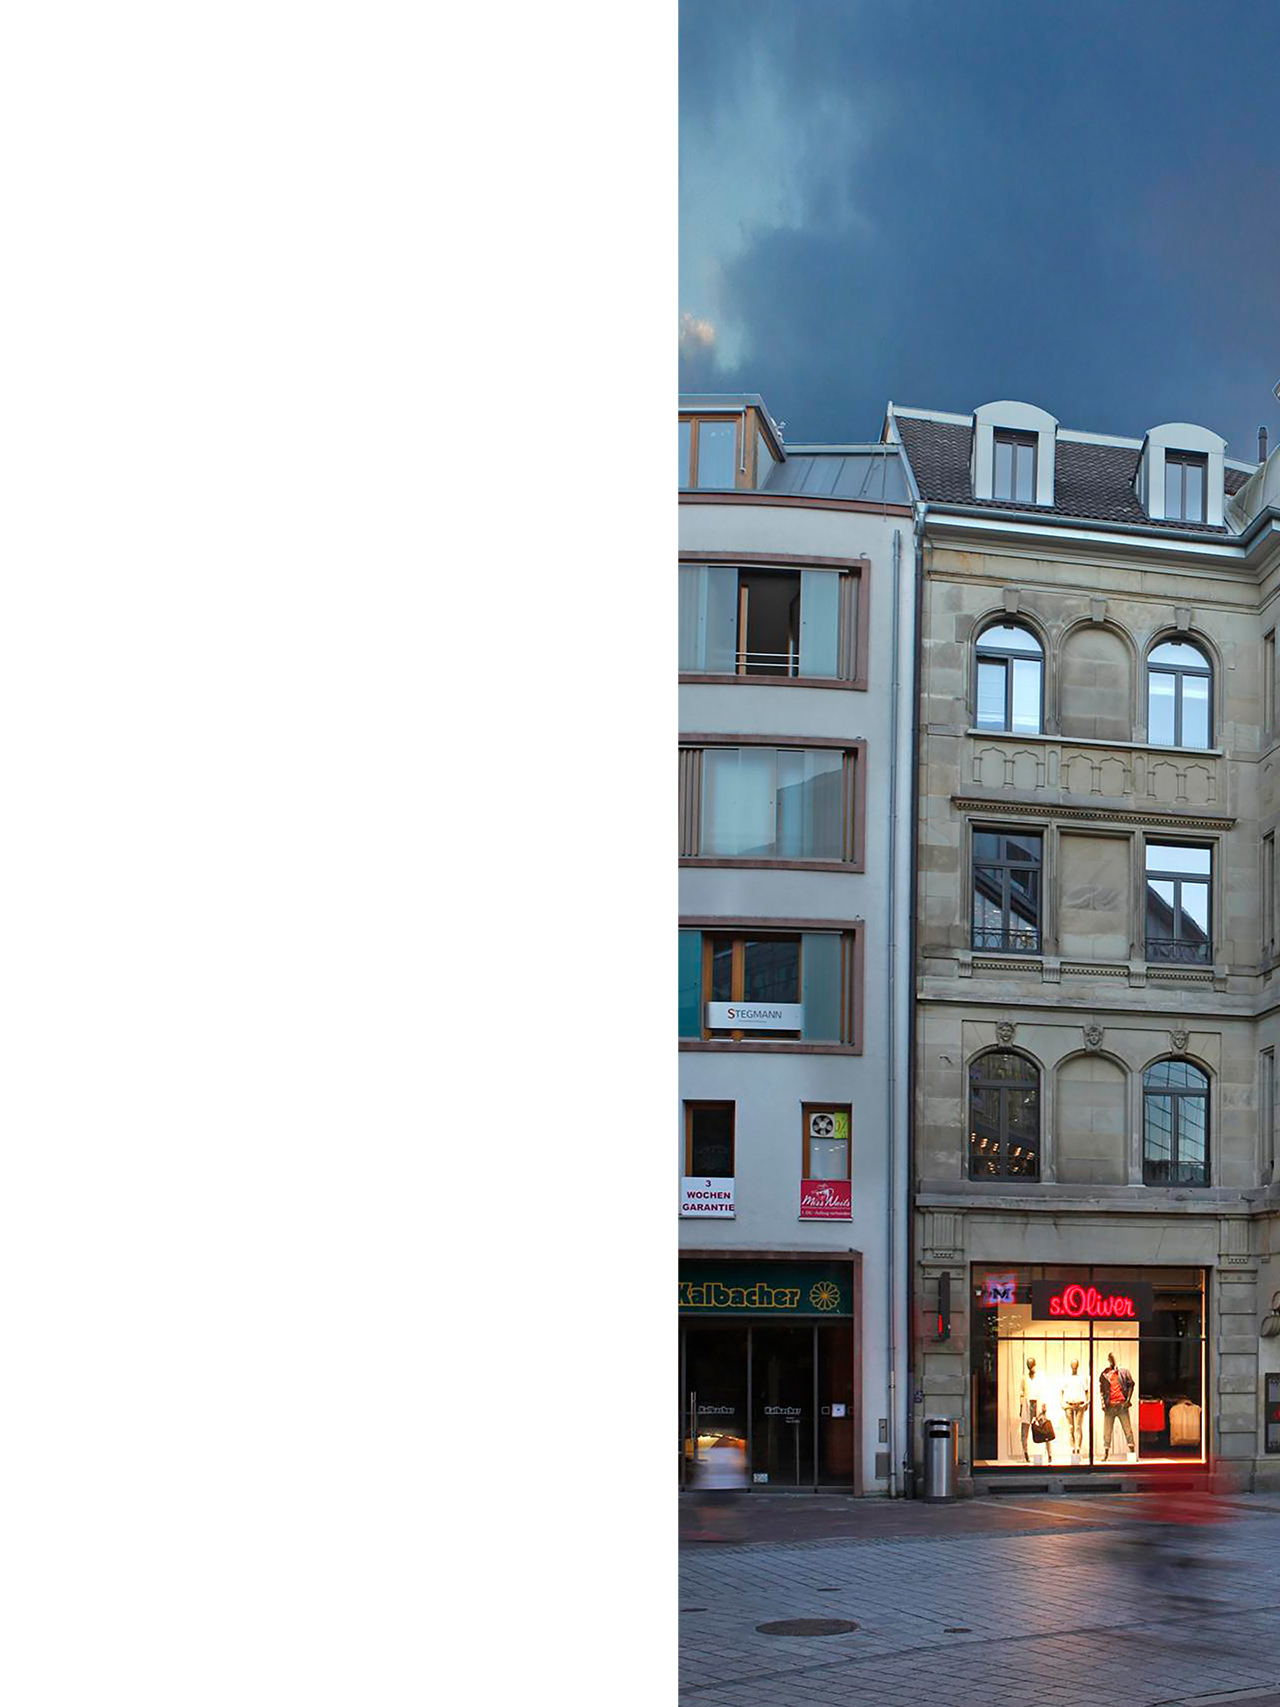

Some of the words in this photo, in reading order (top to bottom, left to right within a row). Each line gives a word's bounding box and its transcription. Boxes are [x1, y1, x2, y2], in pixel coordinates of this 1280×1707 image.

[727, 1008, 782, 1019] STEGMANN
[705, 1179, 712, 1188] 3
[686, 1191, 731, 1200] WOCHEN
[682, 1203, 735, 1212] GARANTIE
[678, 1282, 800, 1308] Kalbacher
[1049, 1283, 1136, 1318] s.Oliver
